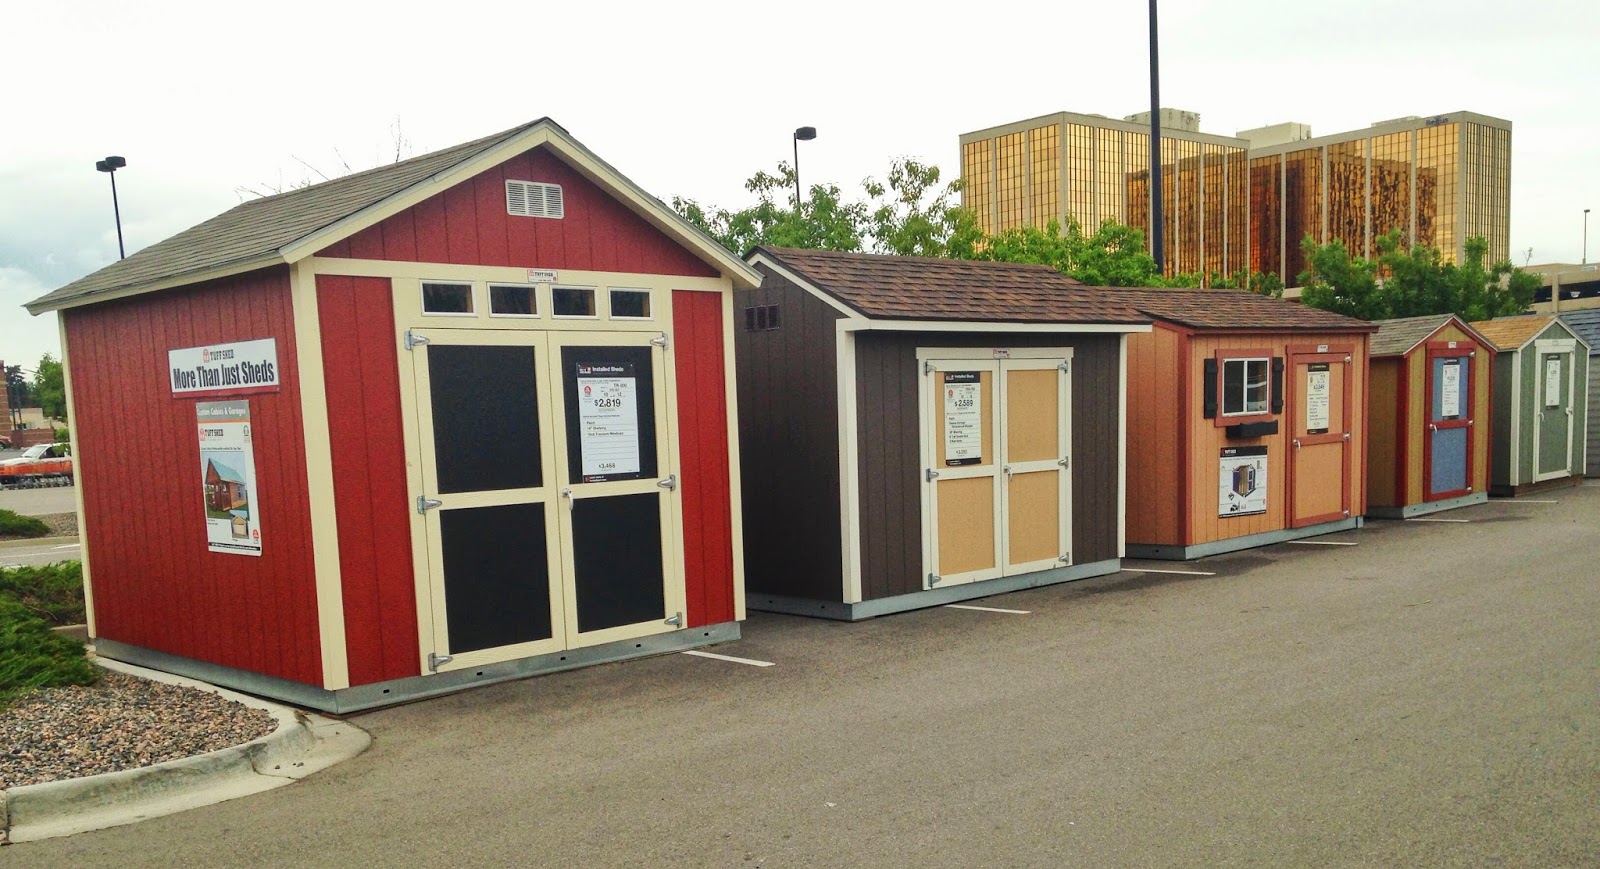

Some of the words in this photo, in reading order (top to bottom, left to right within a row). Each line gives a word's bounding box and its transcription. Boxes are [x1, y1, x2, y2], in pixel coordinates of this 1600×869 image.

[209, 350, 222, 361] TUFF
[222, 349, 234, 359] SHED
[173, 368, 197, 389] More
[196, 366, 220, 387] Than
[221, 363, 242, 386] Just
[241, 359, 275, 384] Sheds
[594, 398, 621, 408] $2,819
